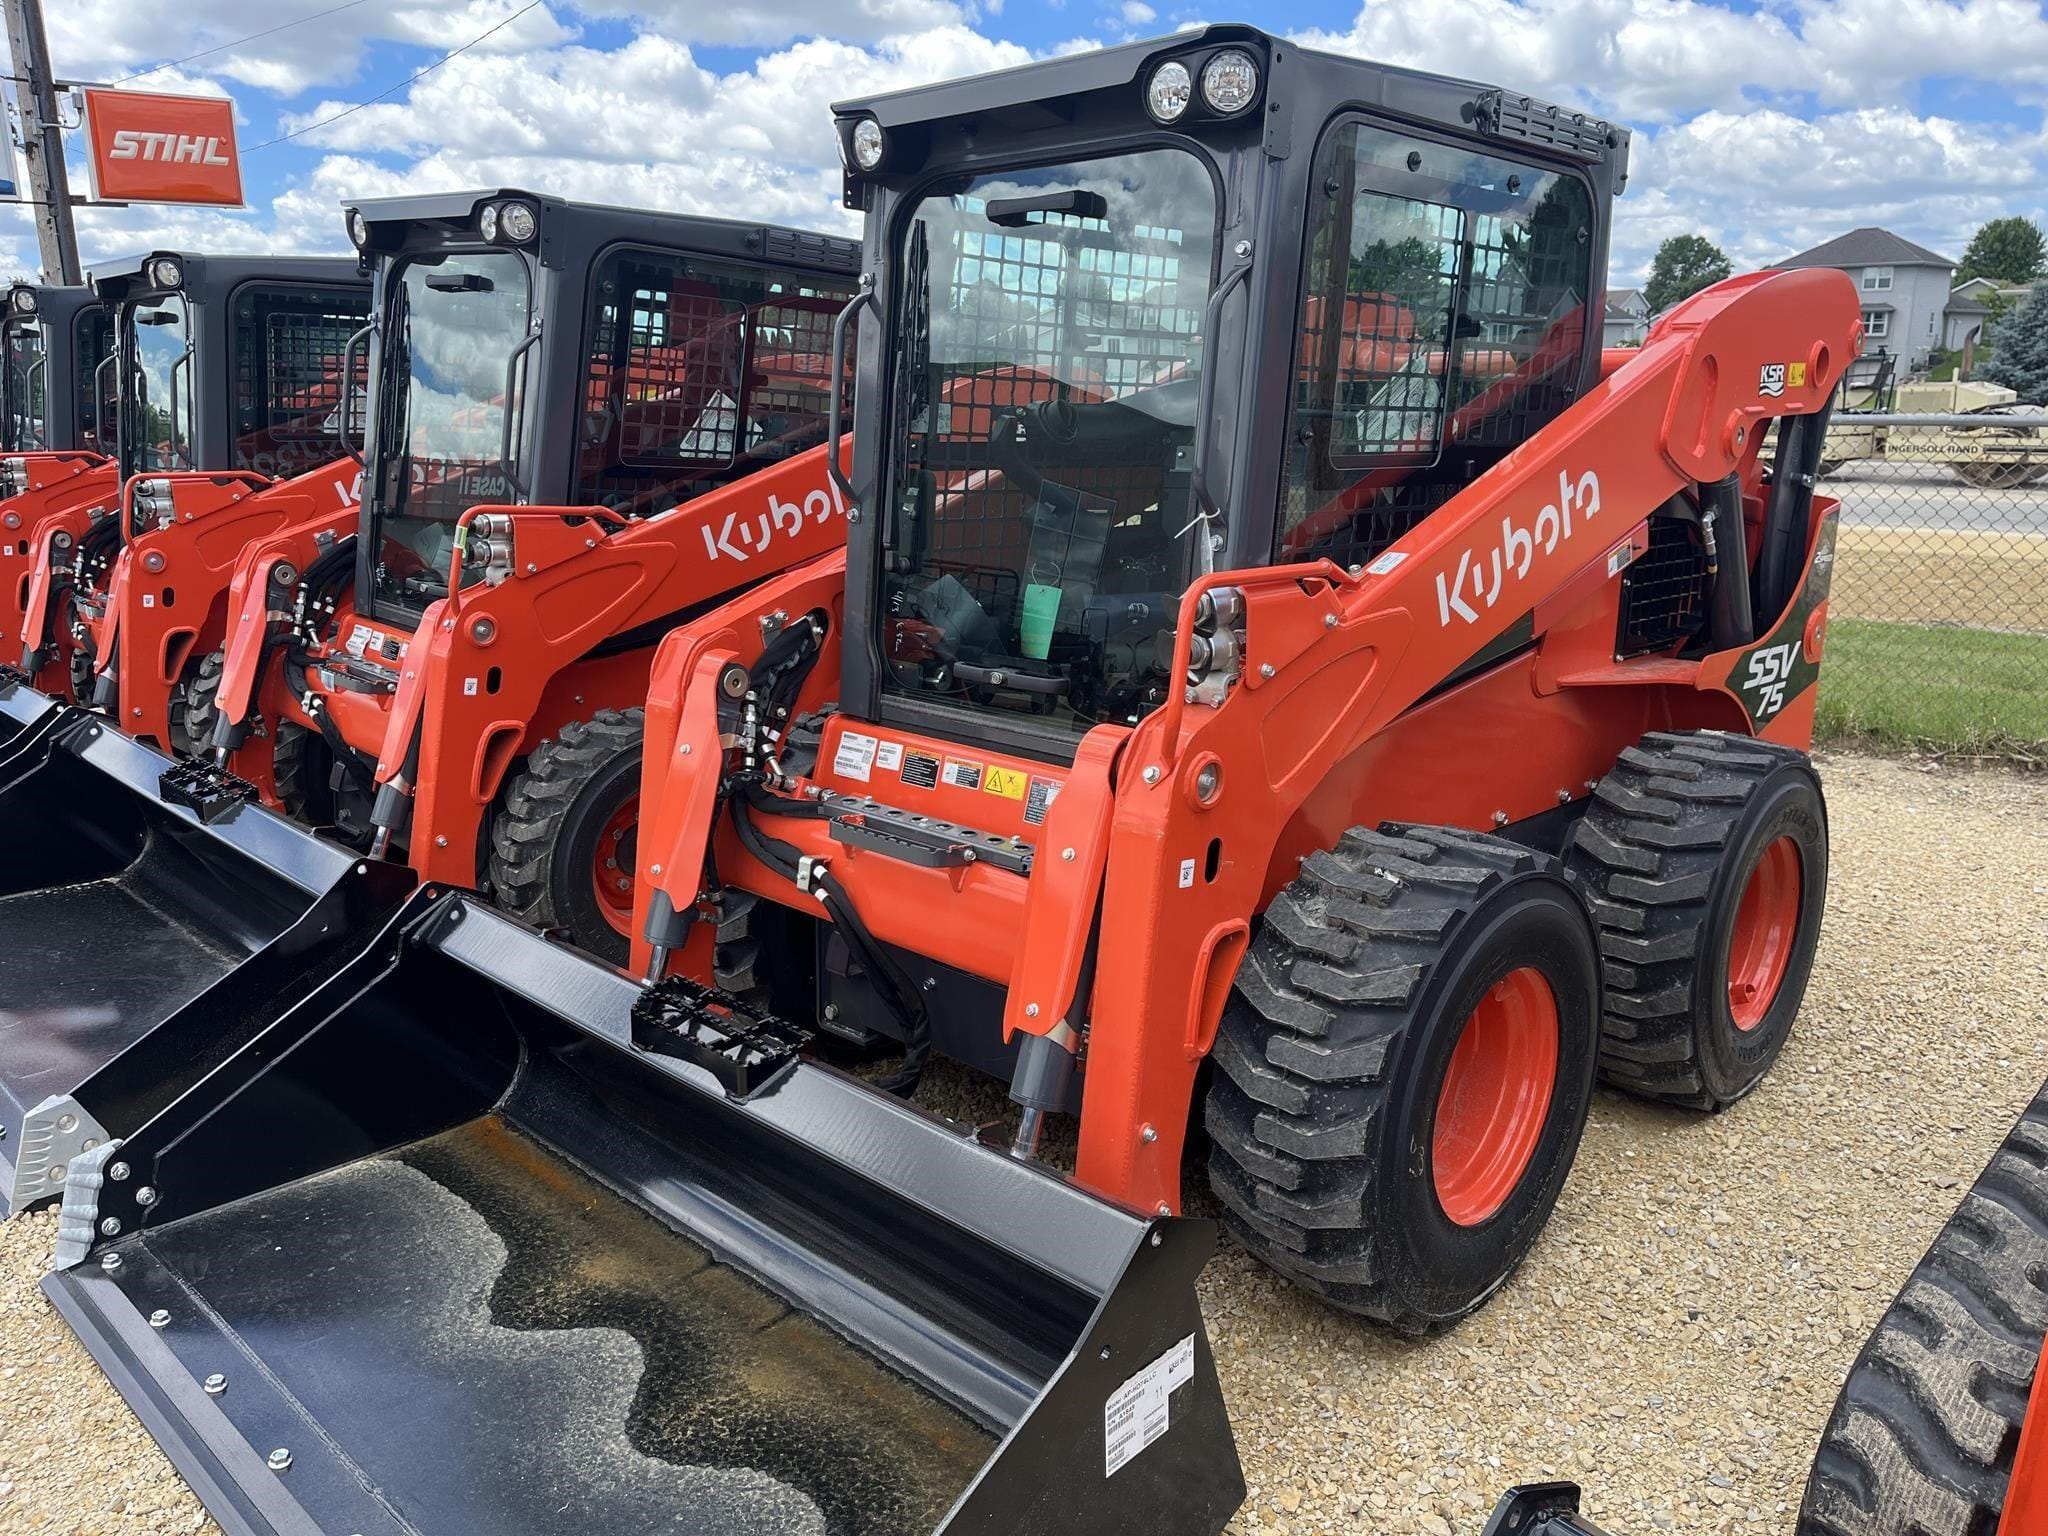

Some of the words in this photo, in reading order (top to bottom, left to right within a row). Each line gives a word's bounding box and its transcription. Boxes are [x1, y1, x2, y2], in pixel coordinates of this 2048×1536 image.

[110, 130, 230, 167] STIHL
[1760, 364, 1785, 383] KSR
[701, 469, 845, 561] Kubot
[1436, 469, 1600, 627] Kubota
[1743, 641, 1801, 690] SSV
[1756, 681, 1786, 717] 75
